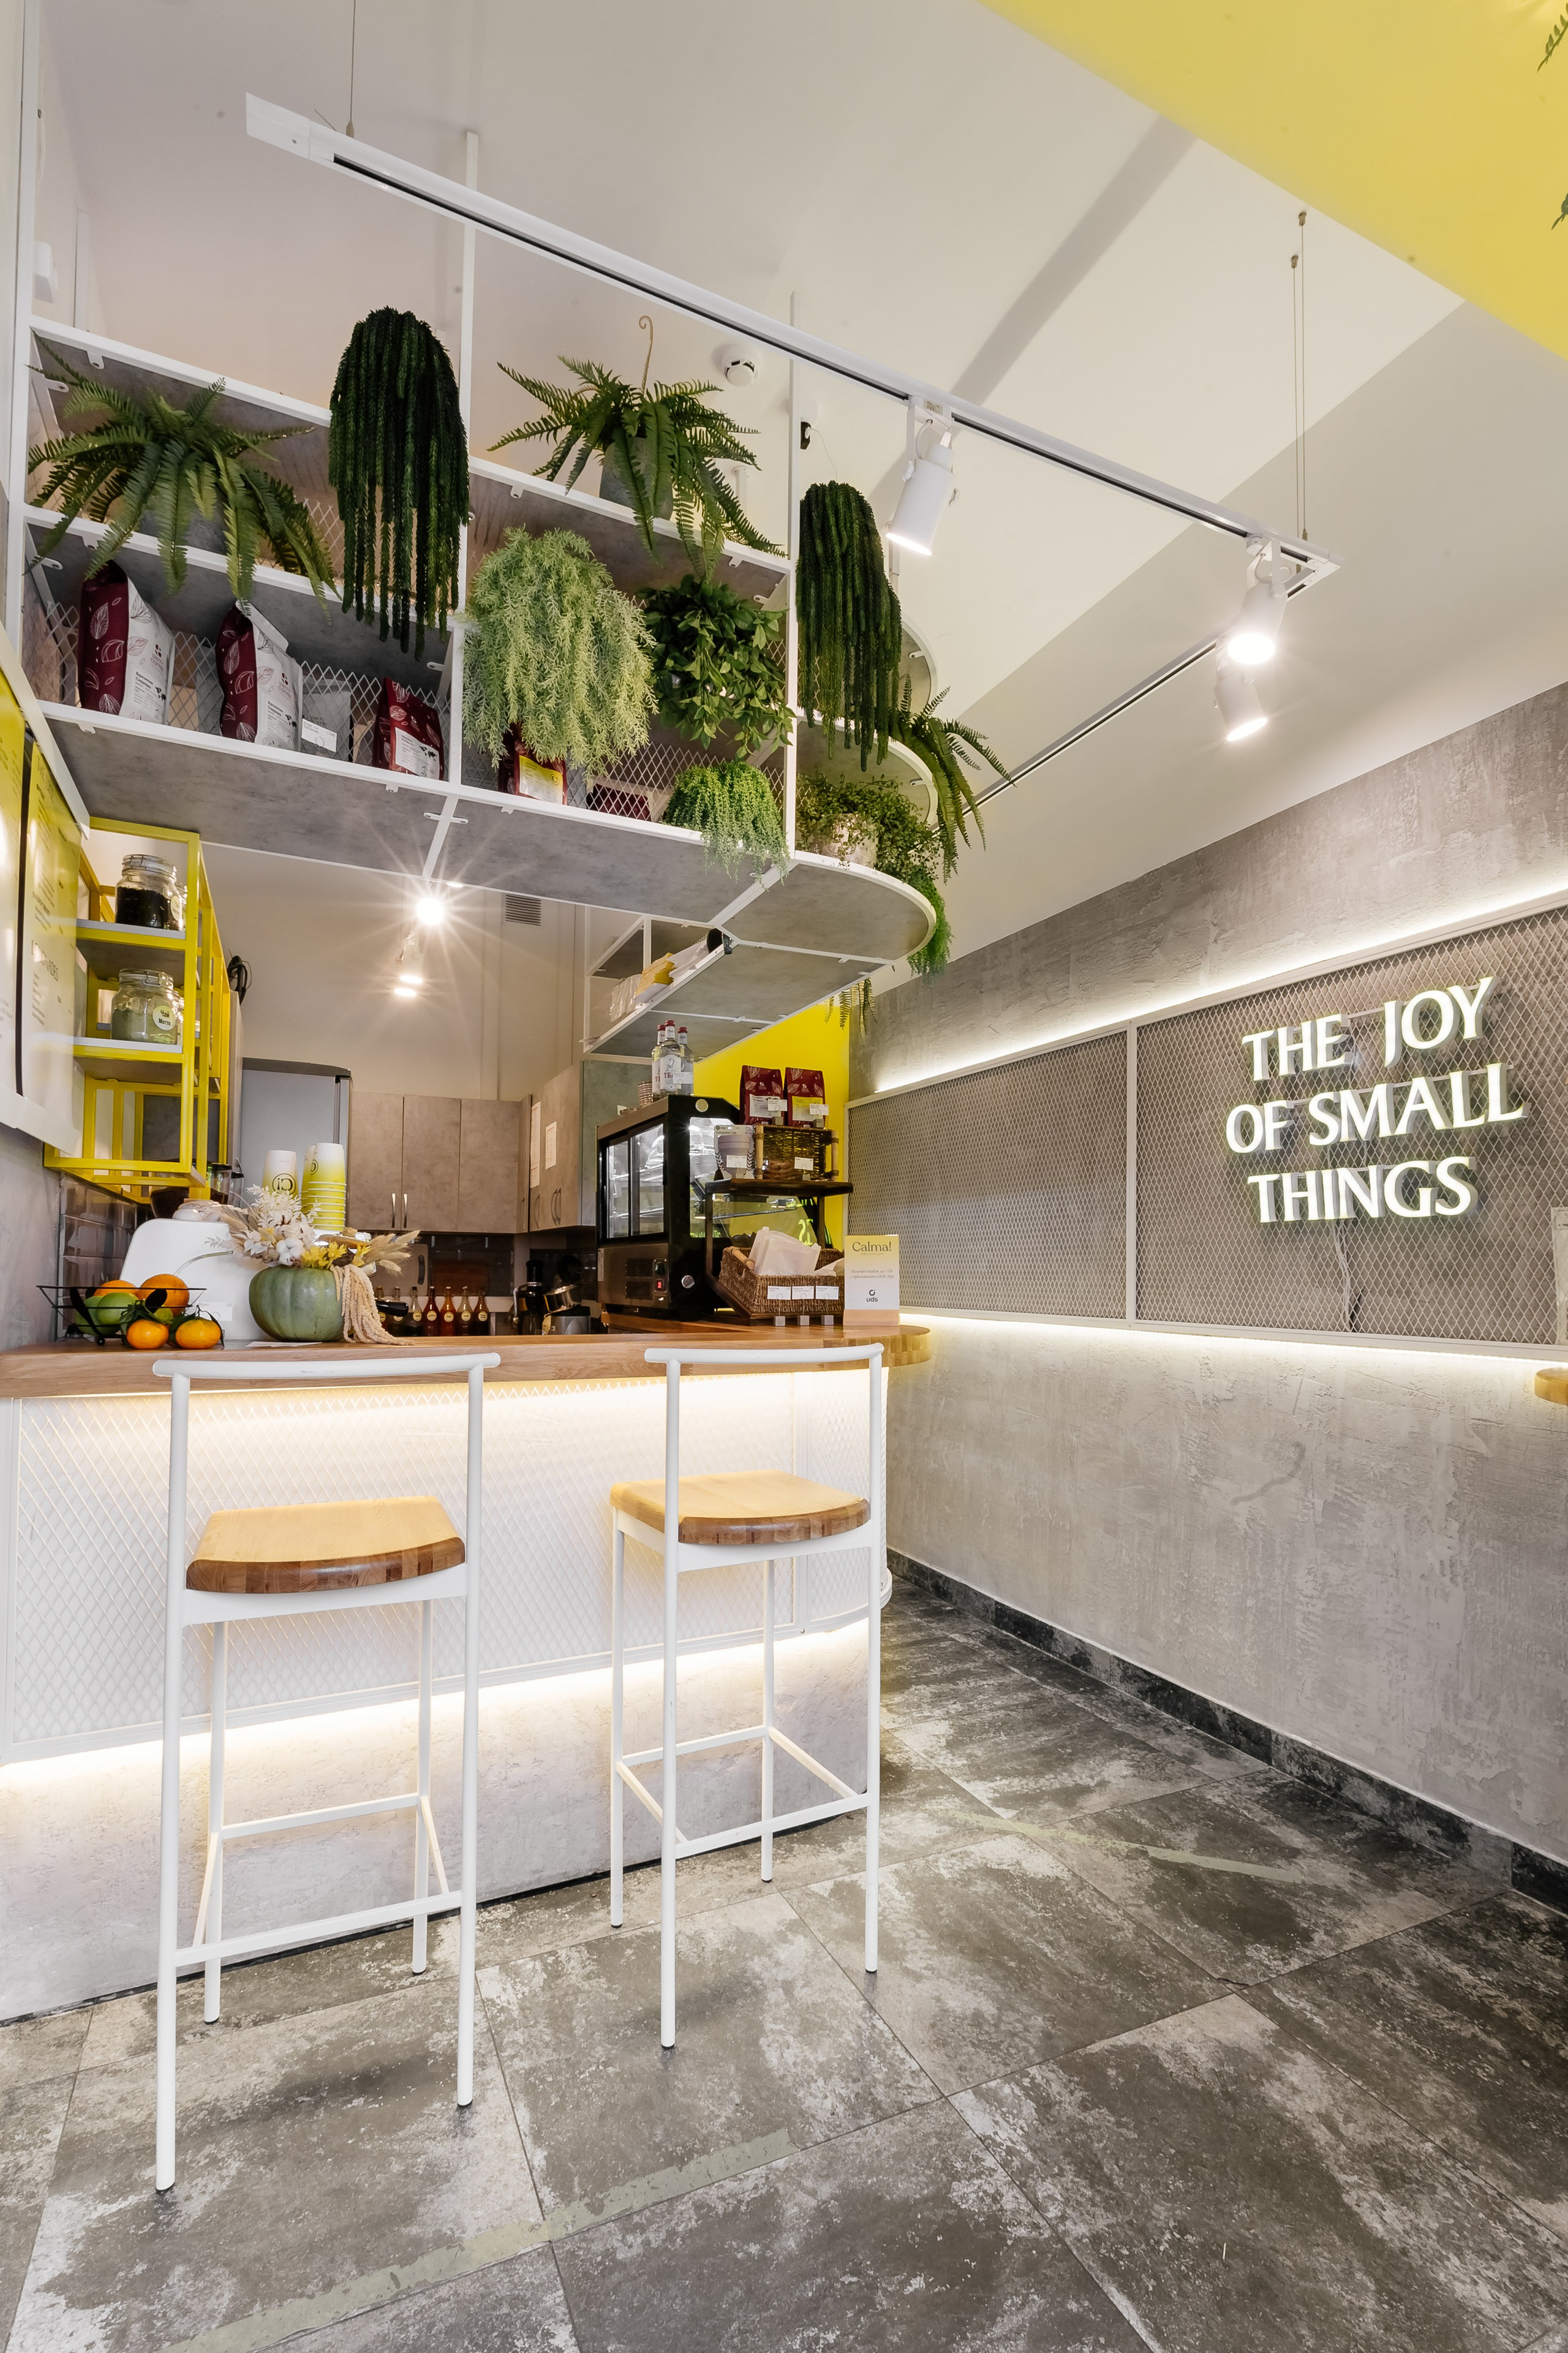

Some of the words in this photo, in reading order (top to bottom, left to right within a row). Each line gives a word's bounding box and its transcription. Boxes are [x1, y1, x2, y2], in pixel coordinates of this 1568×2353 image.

[160, 1010, 170, 1018] Чай
[1242, 1014, 1352, 1082] THE
[1383, 976, 1501, 1068] JOY
[1226, 1100, 1294, 1154] OF
[1309, 1063, 1530, 1146] SMALL
[1248, 1156, 1478, 1224] THINGS
[852, 1241, 891, 1252] Calma!
